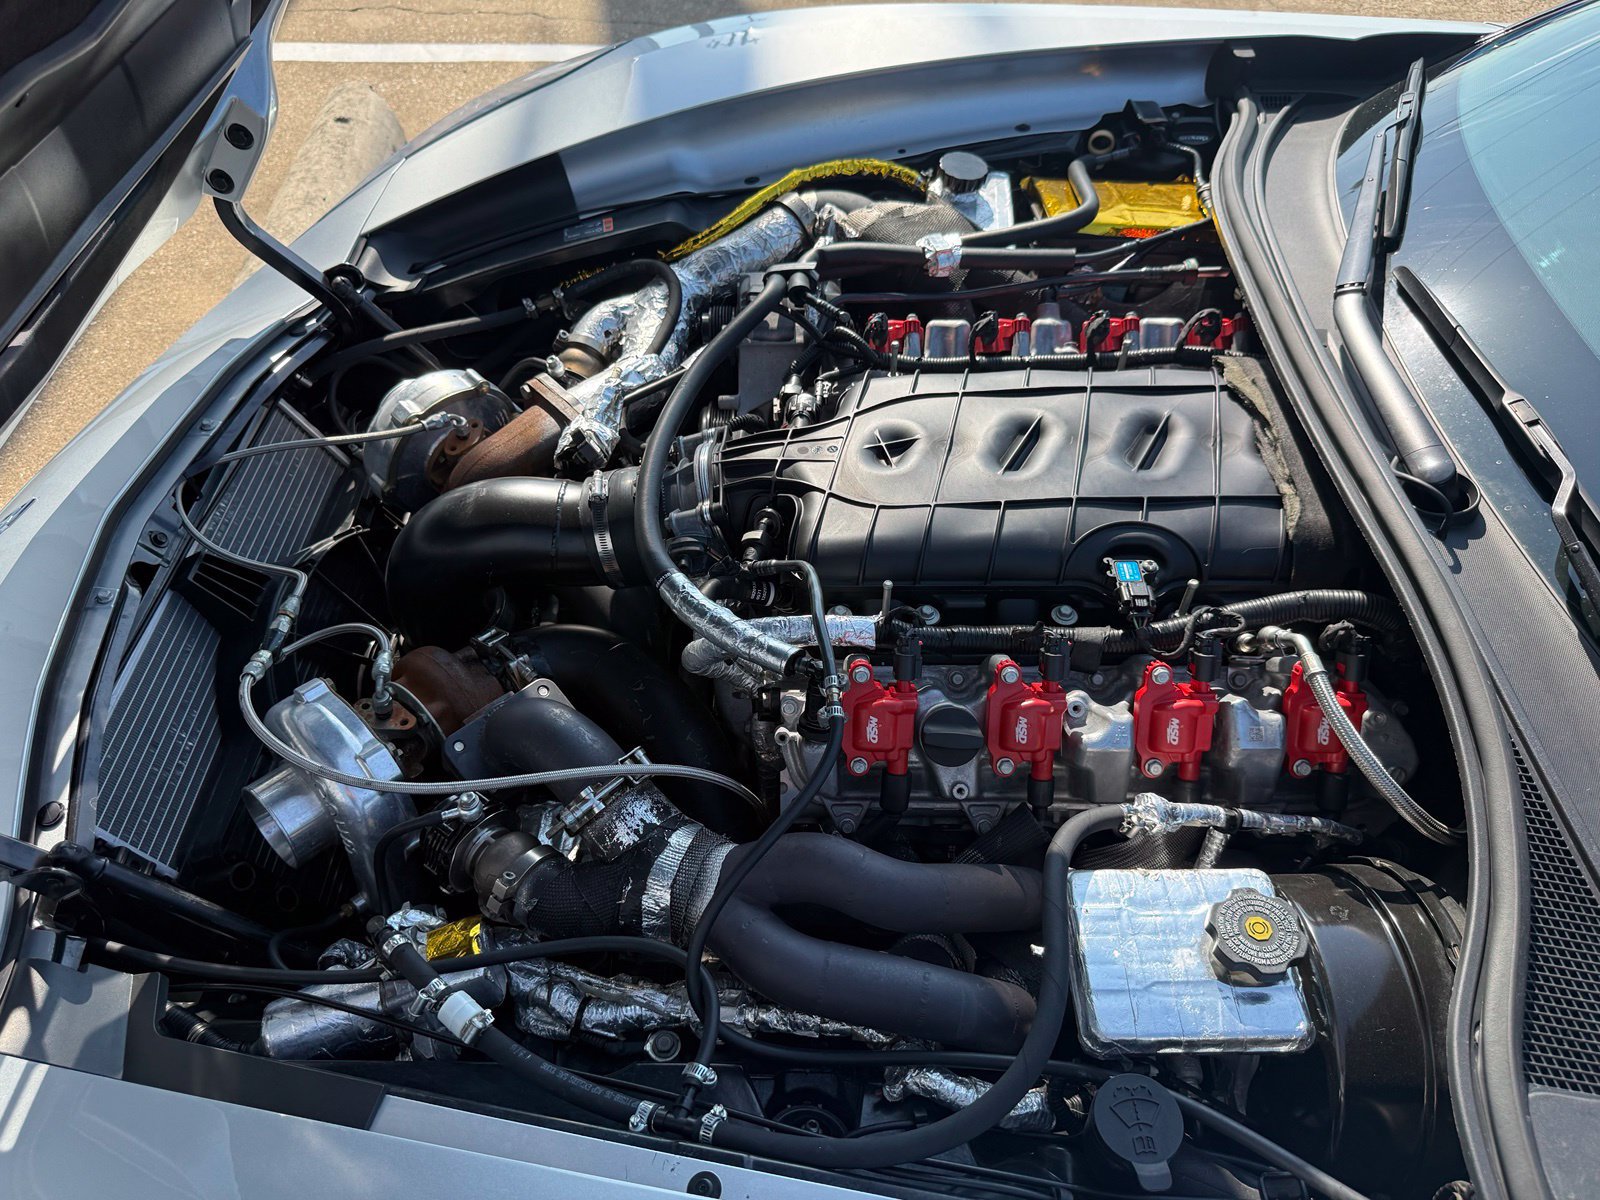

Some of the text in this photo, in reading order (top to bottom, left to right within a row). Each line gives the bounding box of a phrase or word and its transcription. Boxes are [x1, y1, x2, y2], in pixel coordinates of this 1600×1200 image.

[869, 715, 879, 744] MSD
[1018, 715, 1028, 744] MSD
[1170, 717, 1180, 745] MSD
[1320, 717, 1330, 746] MSD
[1265, 903, 1273, 911] DE
[1280, 908, 1290, 916] LA
[1231, 936, 1241, 946] CAP
[1262, 943, 1278, 952] CLEAN
[1274, 931, 1285, 947] FILLER
[1280, 942, 1290, 952] USE
[1284, 932, 1293, 945] ONLY
[1235, 949, 1252, 961] FLUID
[1251, 956, 1266, 964] FROM
[1269, 954, 1288, 964] SEALED
[1283, 935, 1300, 958] CONTAINER
[1238, 943, 1257, 957] BEFORE
